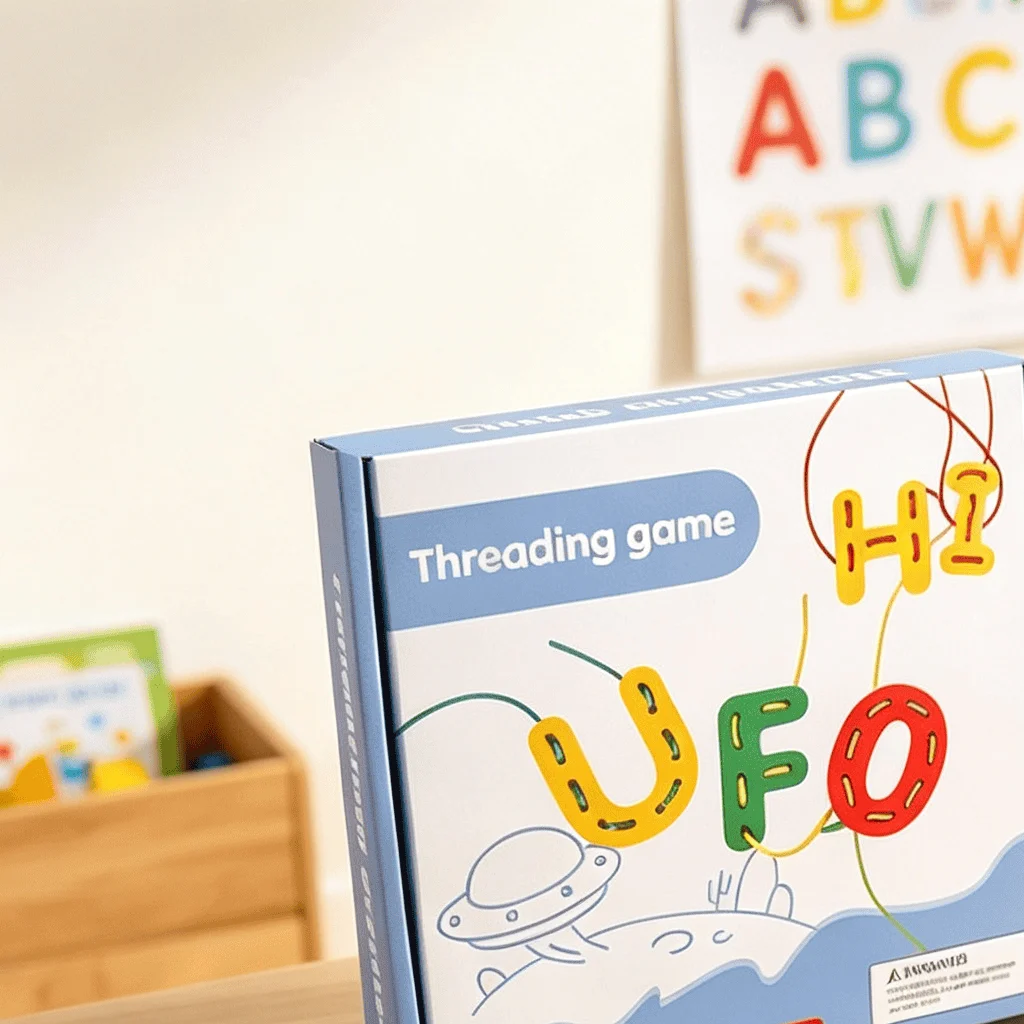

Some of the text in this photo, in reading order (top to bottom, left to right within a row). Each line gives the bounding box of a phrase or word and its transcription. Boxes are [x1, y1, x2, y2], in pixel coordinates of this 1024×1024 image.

[409, 510, 736, 583] Threading game
[832, 461, 1004, 606] HI
[527, 666, 949, 852] UFO
